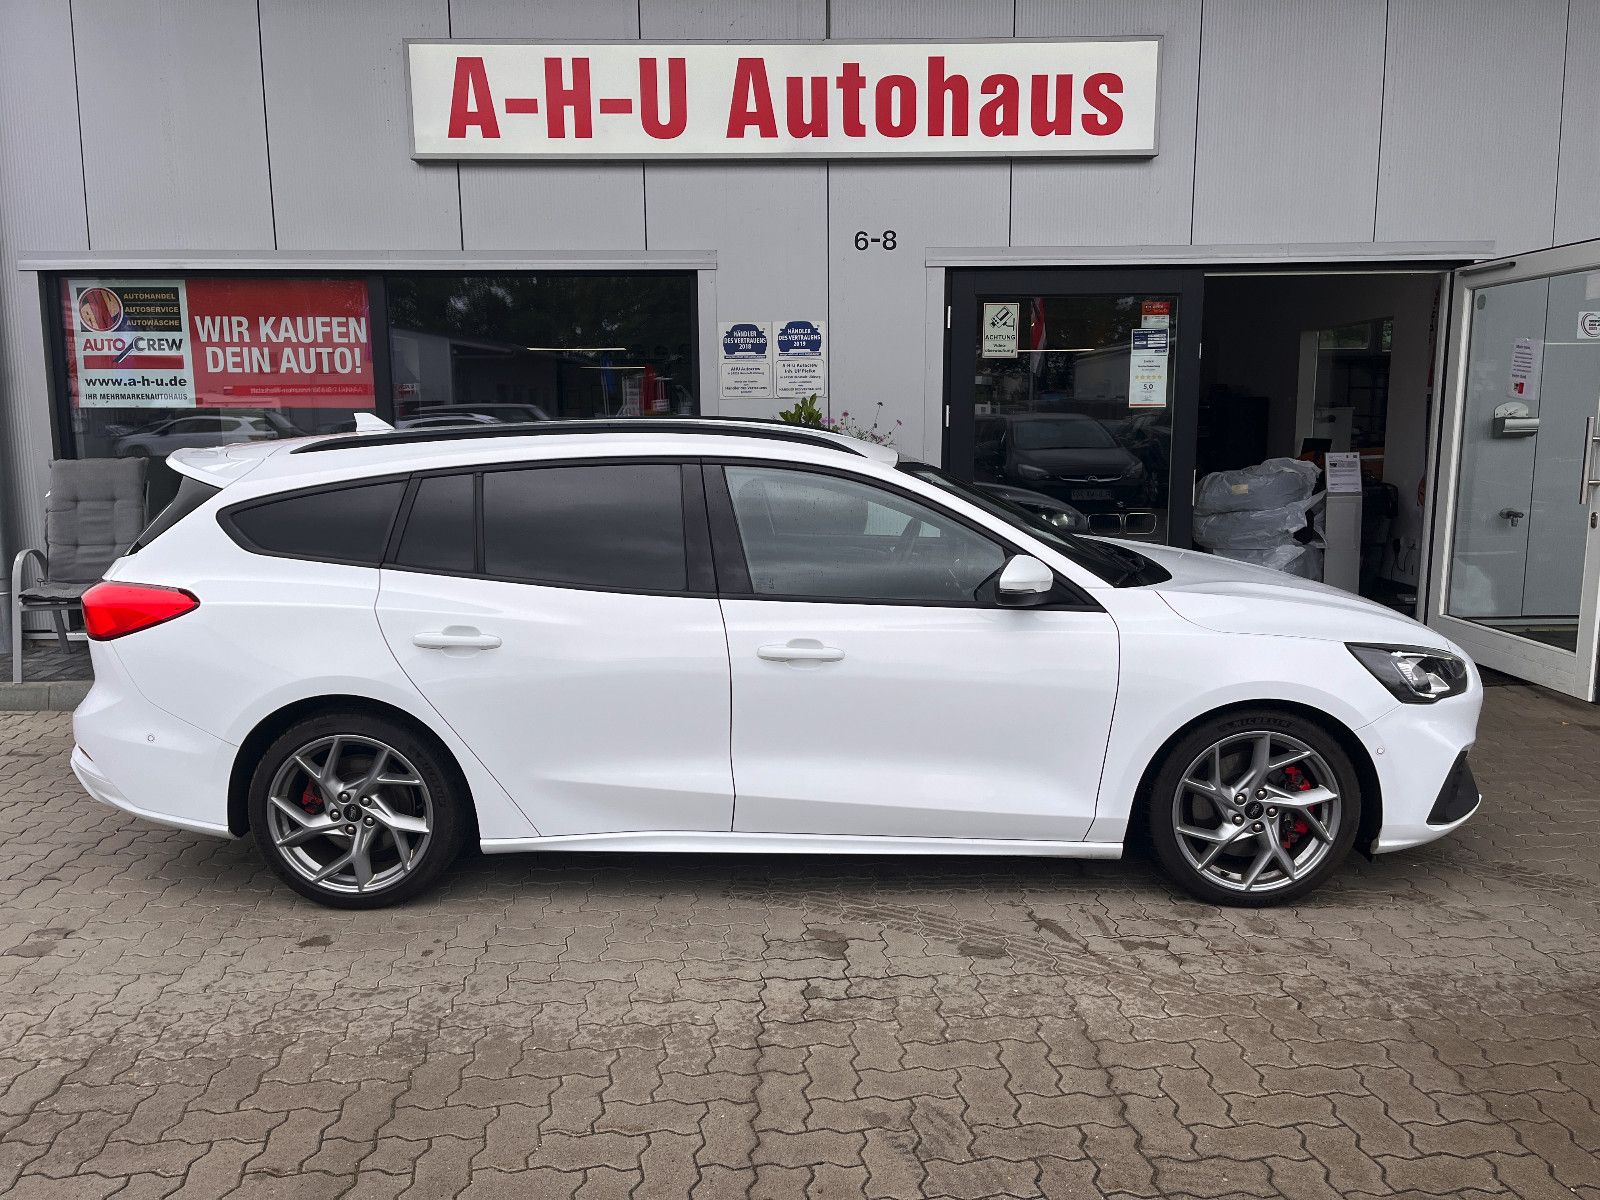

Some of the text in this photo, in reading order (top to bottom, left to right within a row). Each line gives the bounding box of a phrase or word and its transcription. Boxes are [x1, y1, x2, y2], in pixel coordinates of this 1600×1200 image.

[448, 56, 1124, 140] A-H-U Autohaus
[854, 231, 898, 252] 6-8
[194, 315, 368, 344] WIR KAUFEN
[205, 346, 362, 375] DEIN AUTO!
[85, 375, 188, 388] www.a-h-u.de
[1143, 383, 1154, 391] 5,0
[99, 393, 188, 401] MEHRMARKENAUTOHAUS
